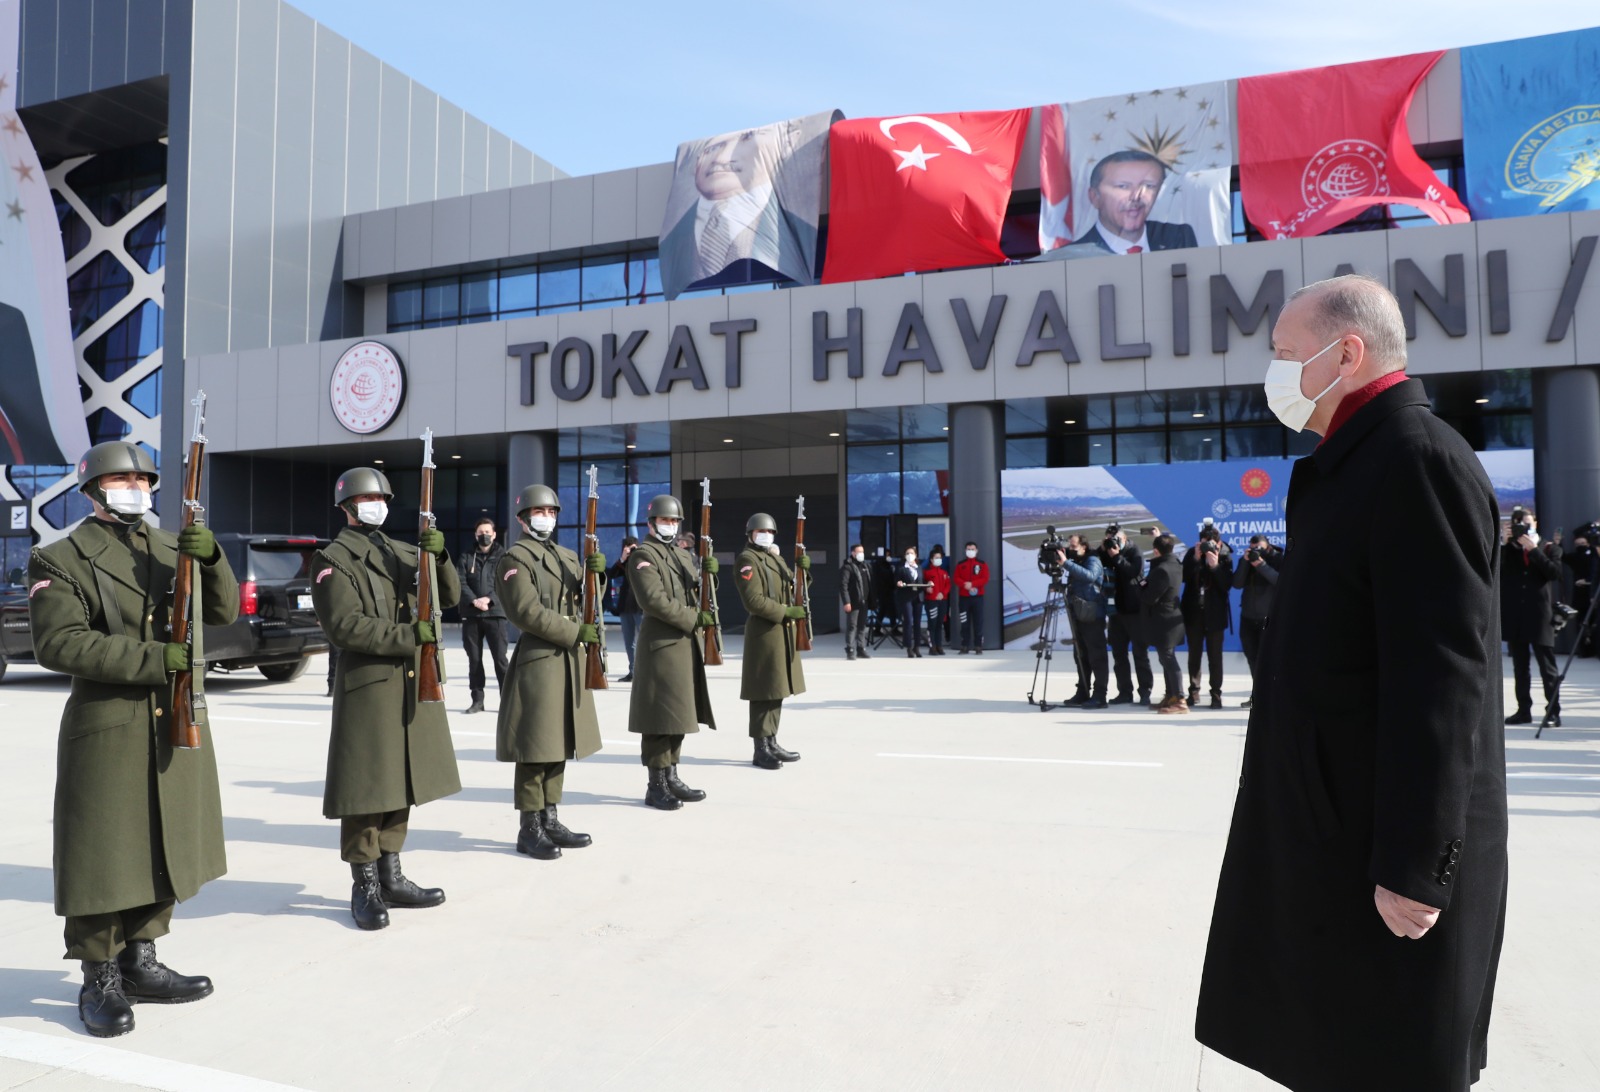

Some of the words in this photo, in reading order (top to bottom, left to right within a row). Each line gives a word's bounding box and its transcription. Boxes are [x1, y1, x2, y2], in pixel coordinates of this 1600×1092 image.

[1514, 138, 1543, 170] HAVA
[507, 318, 757, 407] TOKAT
[811, 249, 1510, 382] HAVALİMNI
[1197, 522, 1236, 534] TKAT
[1240, 518, 1286, 533] HAVALİ
